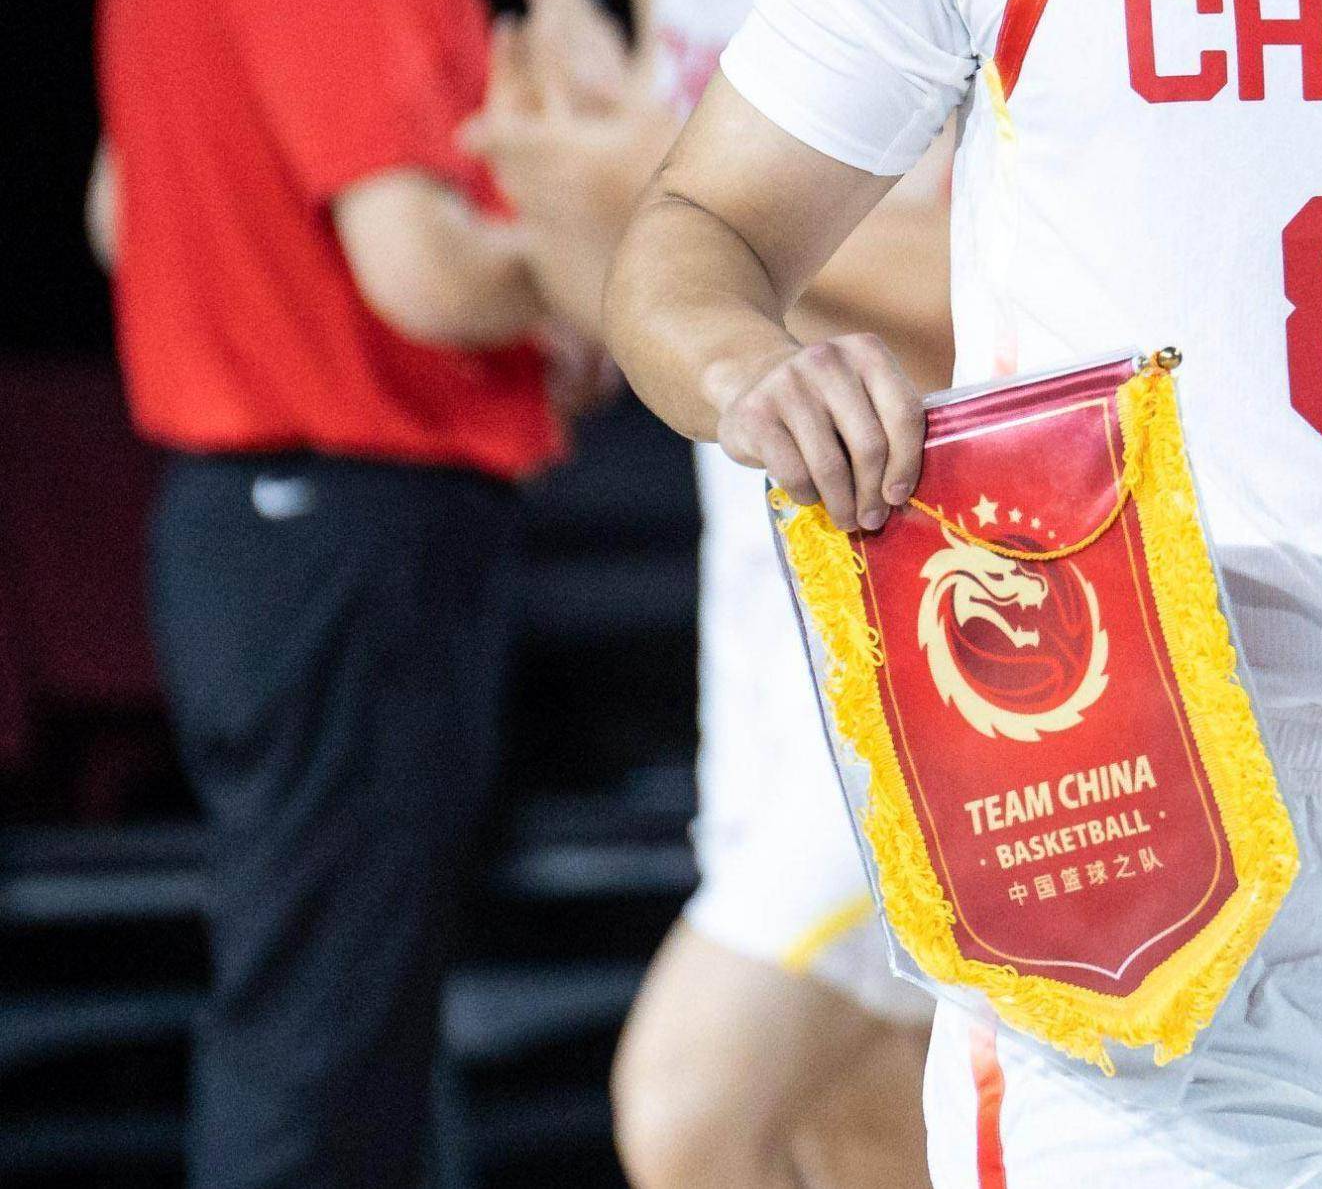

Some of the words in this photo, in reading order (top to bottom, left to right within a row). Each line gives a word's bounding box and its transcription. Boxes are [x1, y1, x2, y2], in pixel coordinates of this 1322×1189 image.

[964, 780, 1054, 836] TEAM
[1057, 754, 1157, 810] CHINA
[996, 809, 1151, 870] BASKETBALL
[1008, 846, 1164, 906] 中国篮球之队
